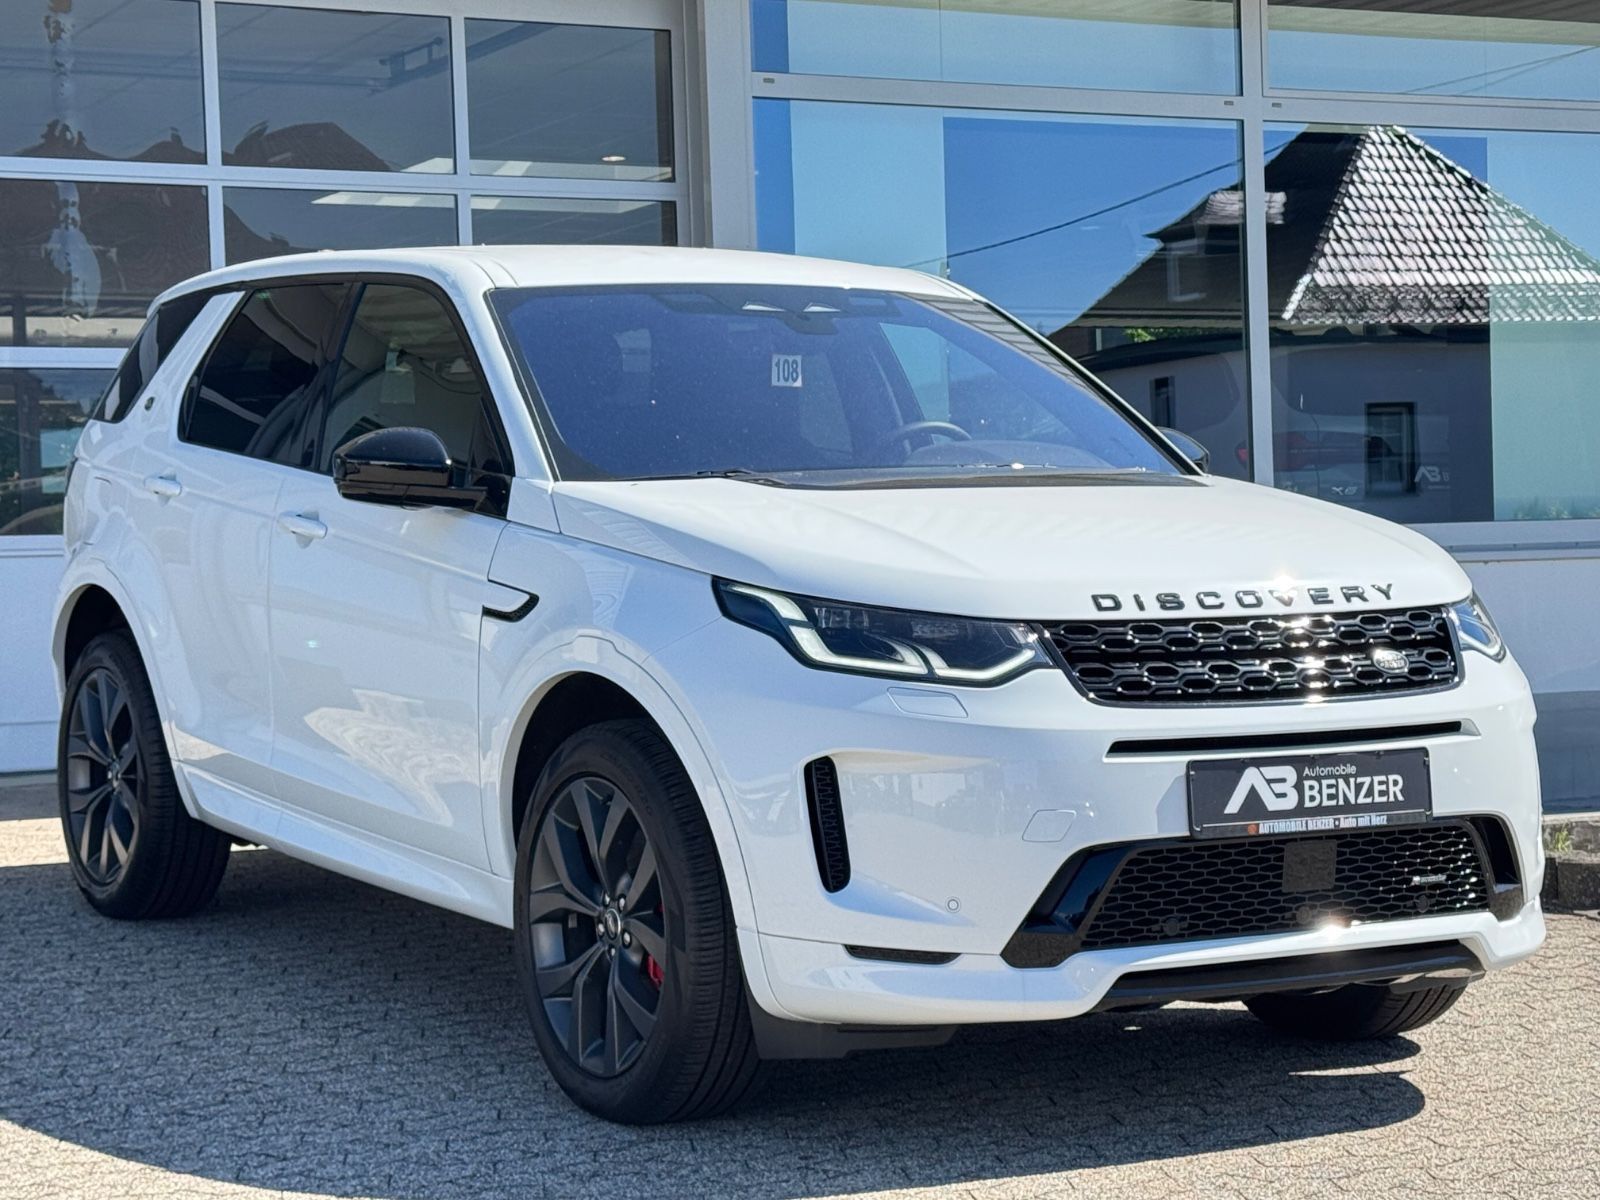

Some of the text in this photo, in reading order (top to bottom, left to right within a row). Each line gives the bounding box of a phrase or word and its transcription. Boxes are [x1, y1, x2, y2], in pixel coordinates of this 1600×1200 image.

[774, 357, 800, 384] 108
[1090, 582, 1393, 612] DISCOVERY
[1302, 763, 1357, 778] Automobile
[1302, 774, 1405, 809] BENZER
[1258, 819, 1307, 835] AUTOMOBILE
